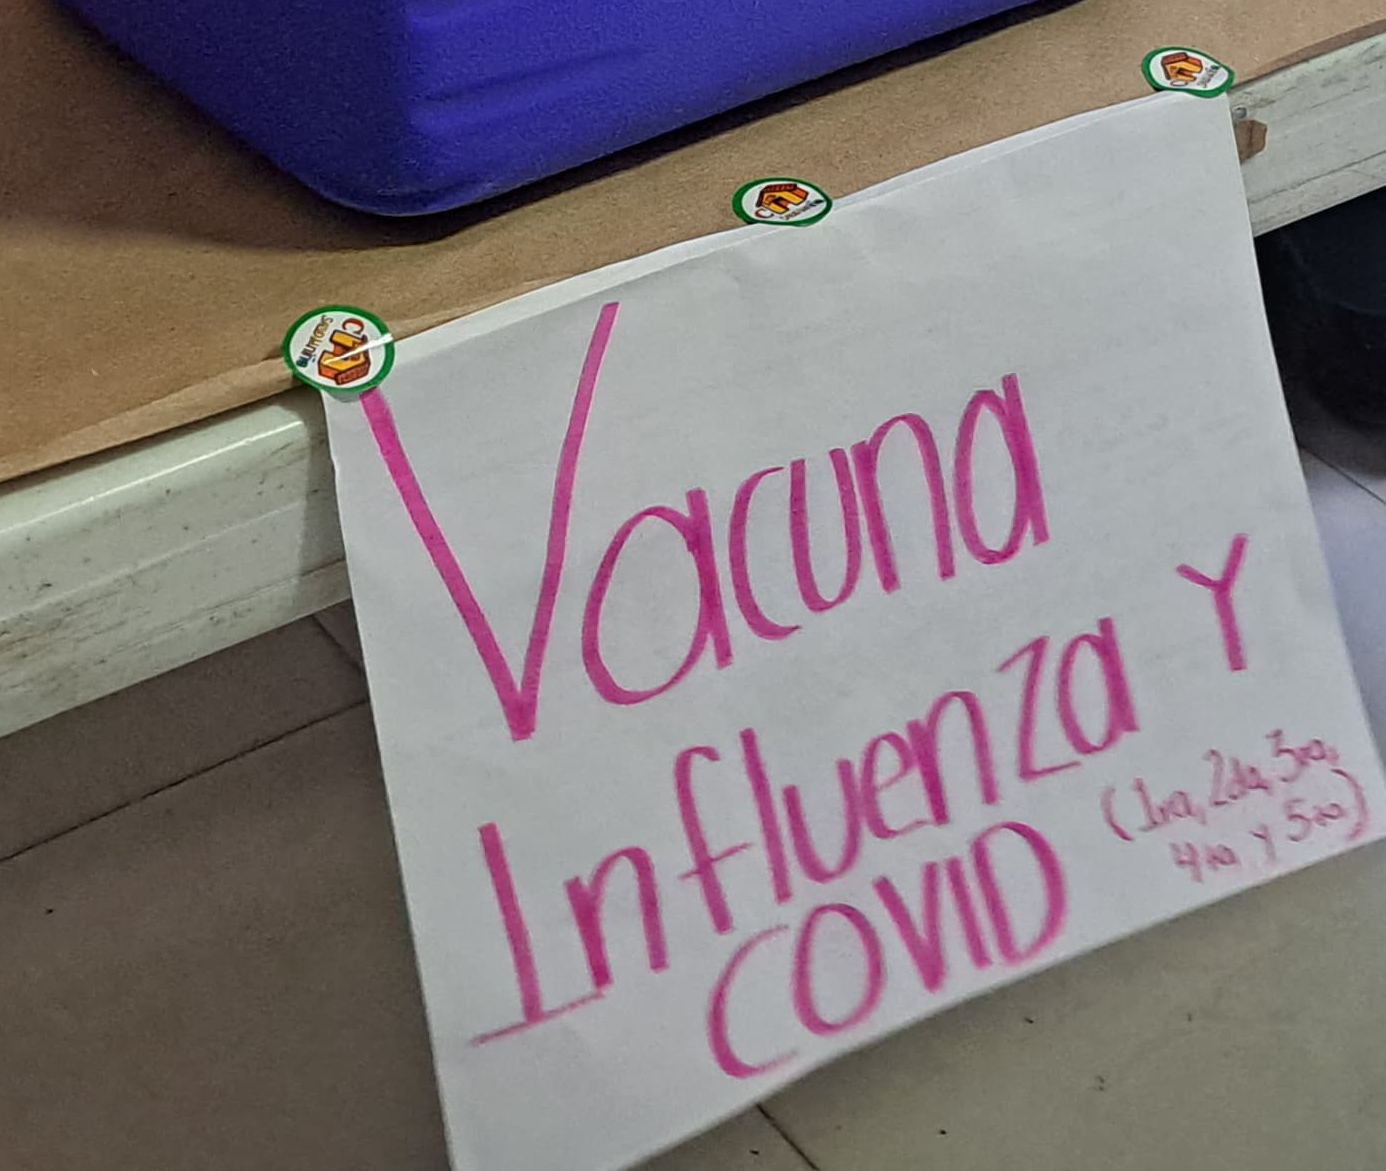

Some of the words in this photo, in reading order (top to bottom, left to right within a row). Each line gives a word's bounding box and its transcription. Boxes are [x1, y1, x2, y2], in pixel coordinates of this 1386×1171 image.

[361, 301, 1051, 743] Vacuna
[470, 617, 1139, 1045] Influenza
[706, 820, 1069, 1081] COVID
